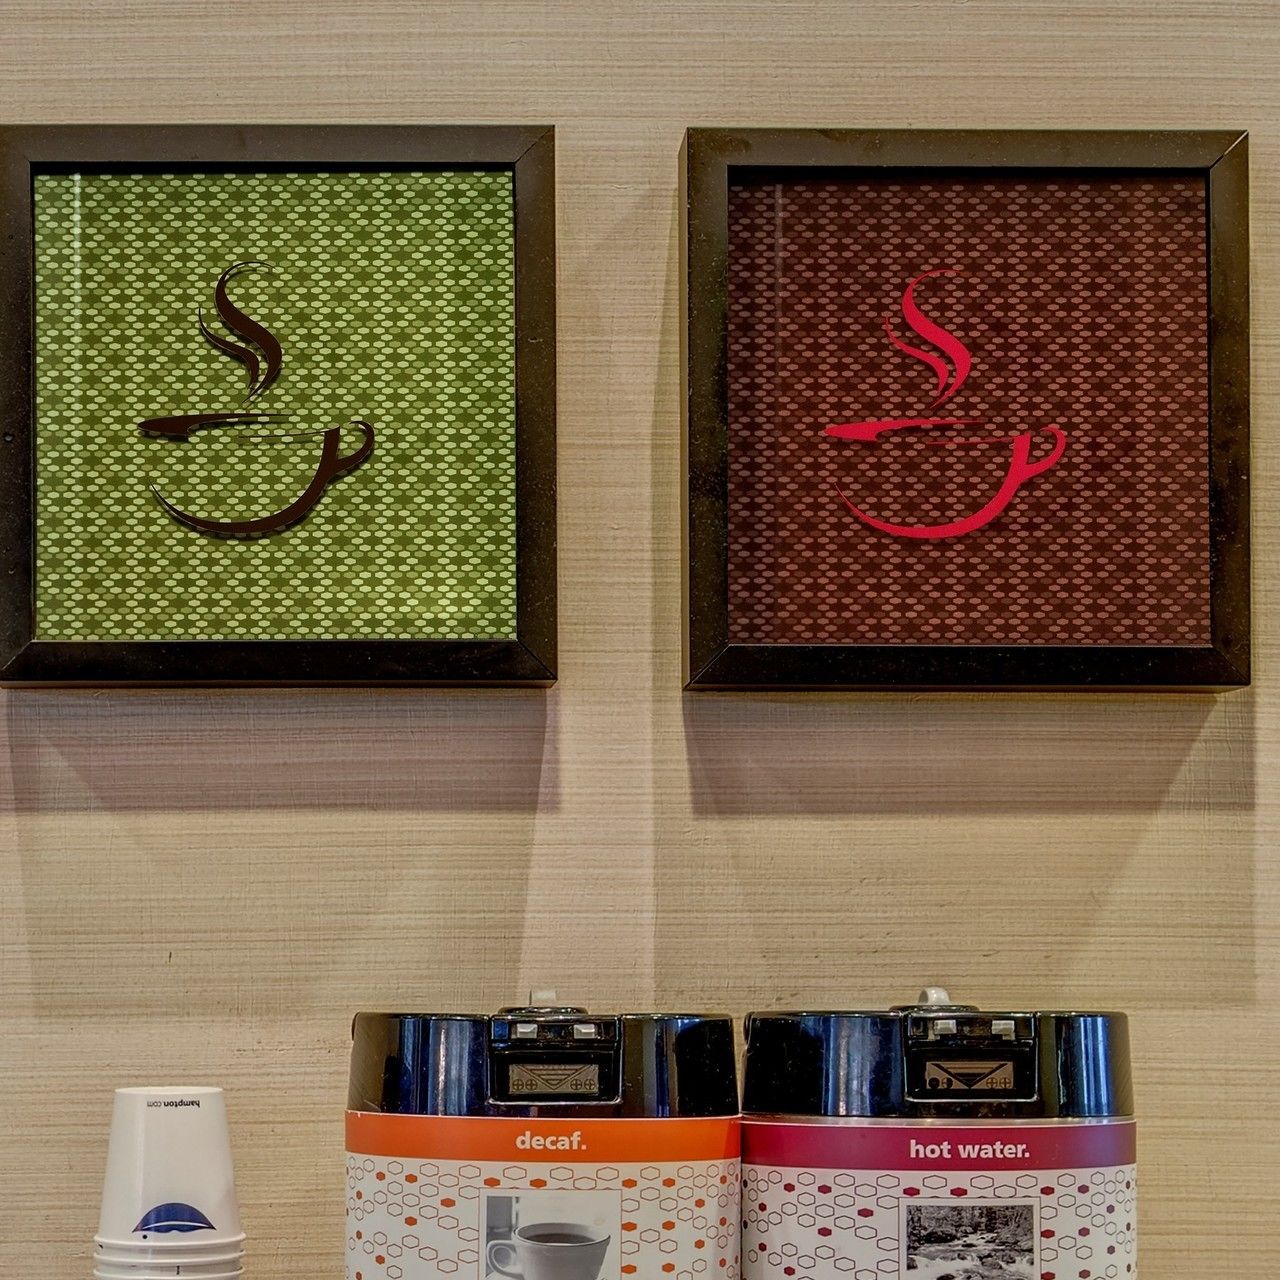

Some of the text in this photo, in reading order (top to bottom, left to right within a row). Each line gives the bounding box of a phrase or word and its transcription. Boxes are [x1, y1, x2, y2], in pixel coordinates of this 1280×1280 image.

[516, 1130, 587, 1150] decaf.
[909, 1139, 1030, 1159] hot water.
